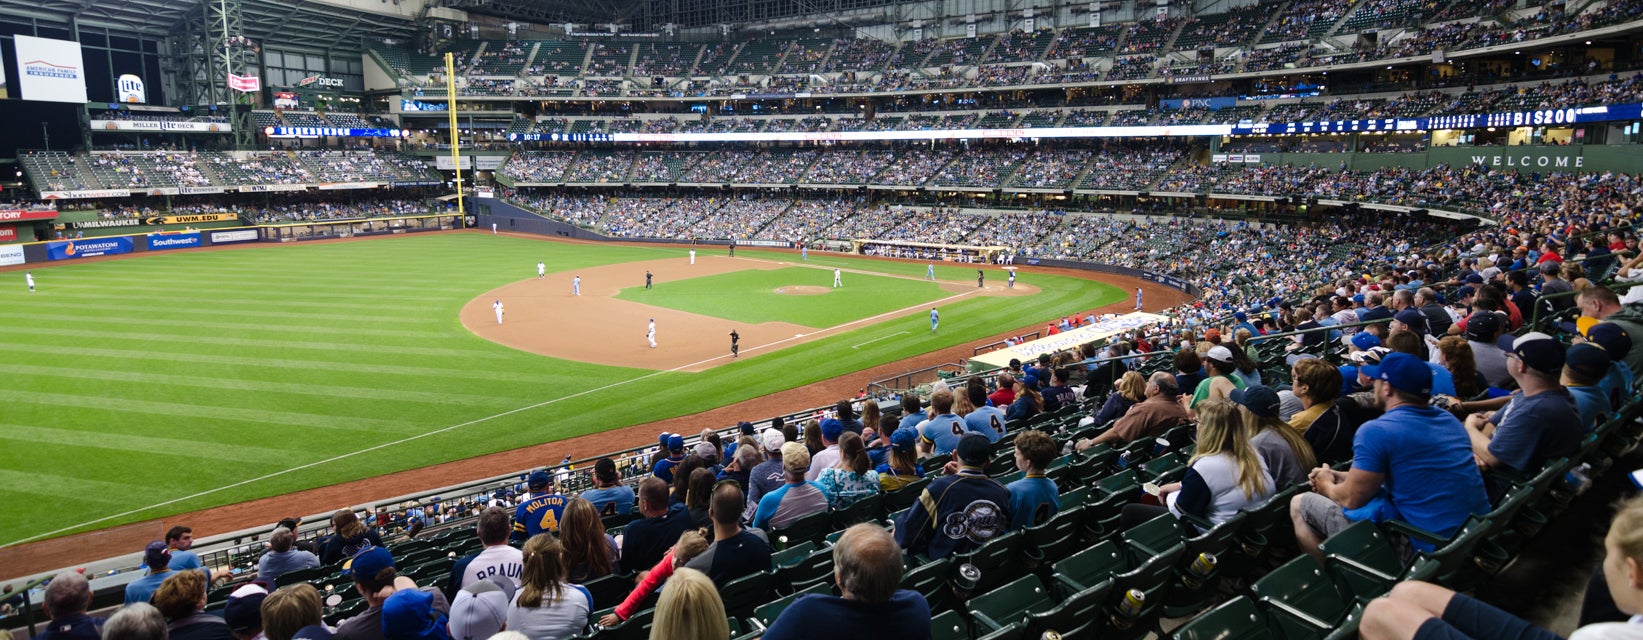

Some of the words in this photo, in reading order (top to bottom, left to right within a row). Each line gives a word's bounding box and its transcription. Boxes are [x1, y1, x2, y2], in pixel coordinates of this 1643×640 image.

[121, 80, 141, 93] Lite
[318, 78, 343, 87] DECK
[1192, 99, 1211, 107] PNC
[159, 121, 176, 130] Lite
[523, 133, 541, 141] 10:17
[1472, 156, 1584, 167] WELCOME
[75, 242, 118, 250] POTAWATOMI
[152, 237, 192, 246] Southwest
[952, 421, 965, 436] 4
[989, 414, 1004, 434] 4
[525, 497, 564, 514] MOLITOR
[539, 508, 559, 531] 4
